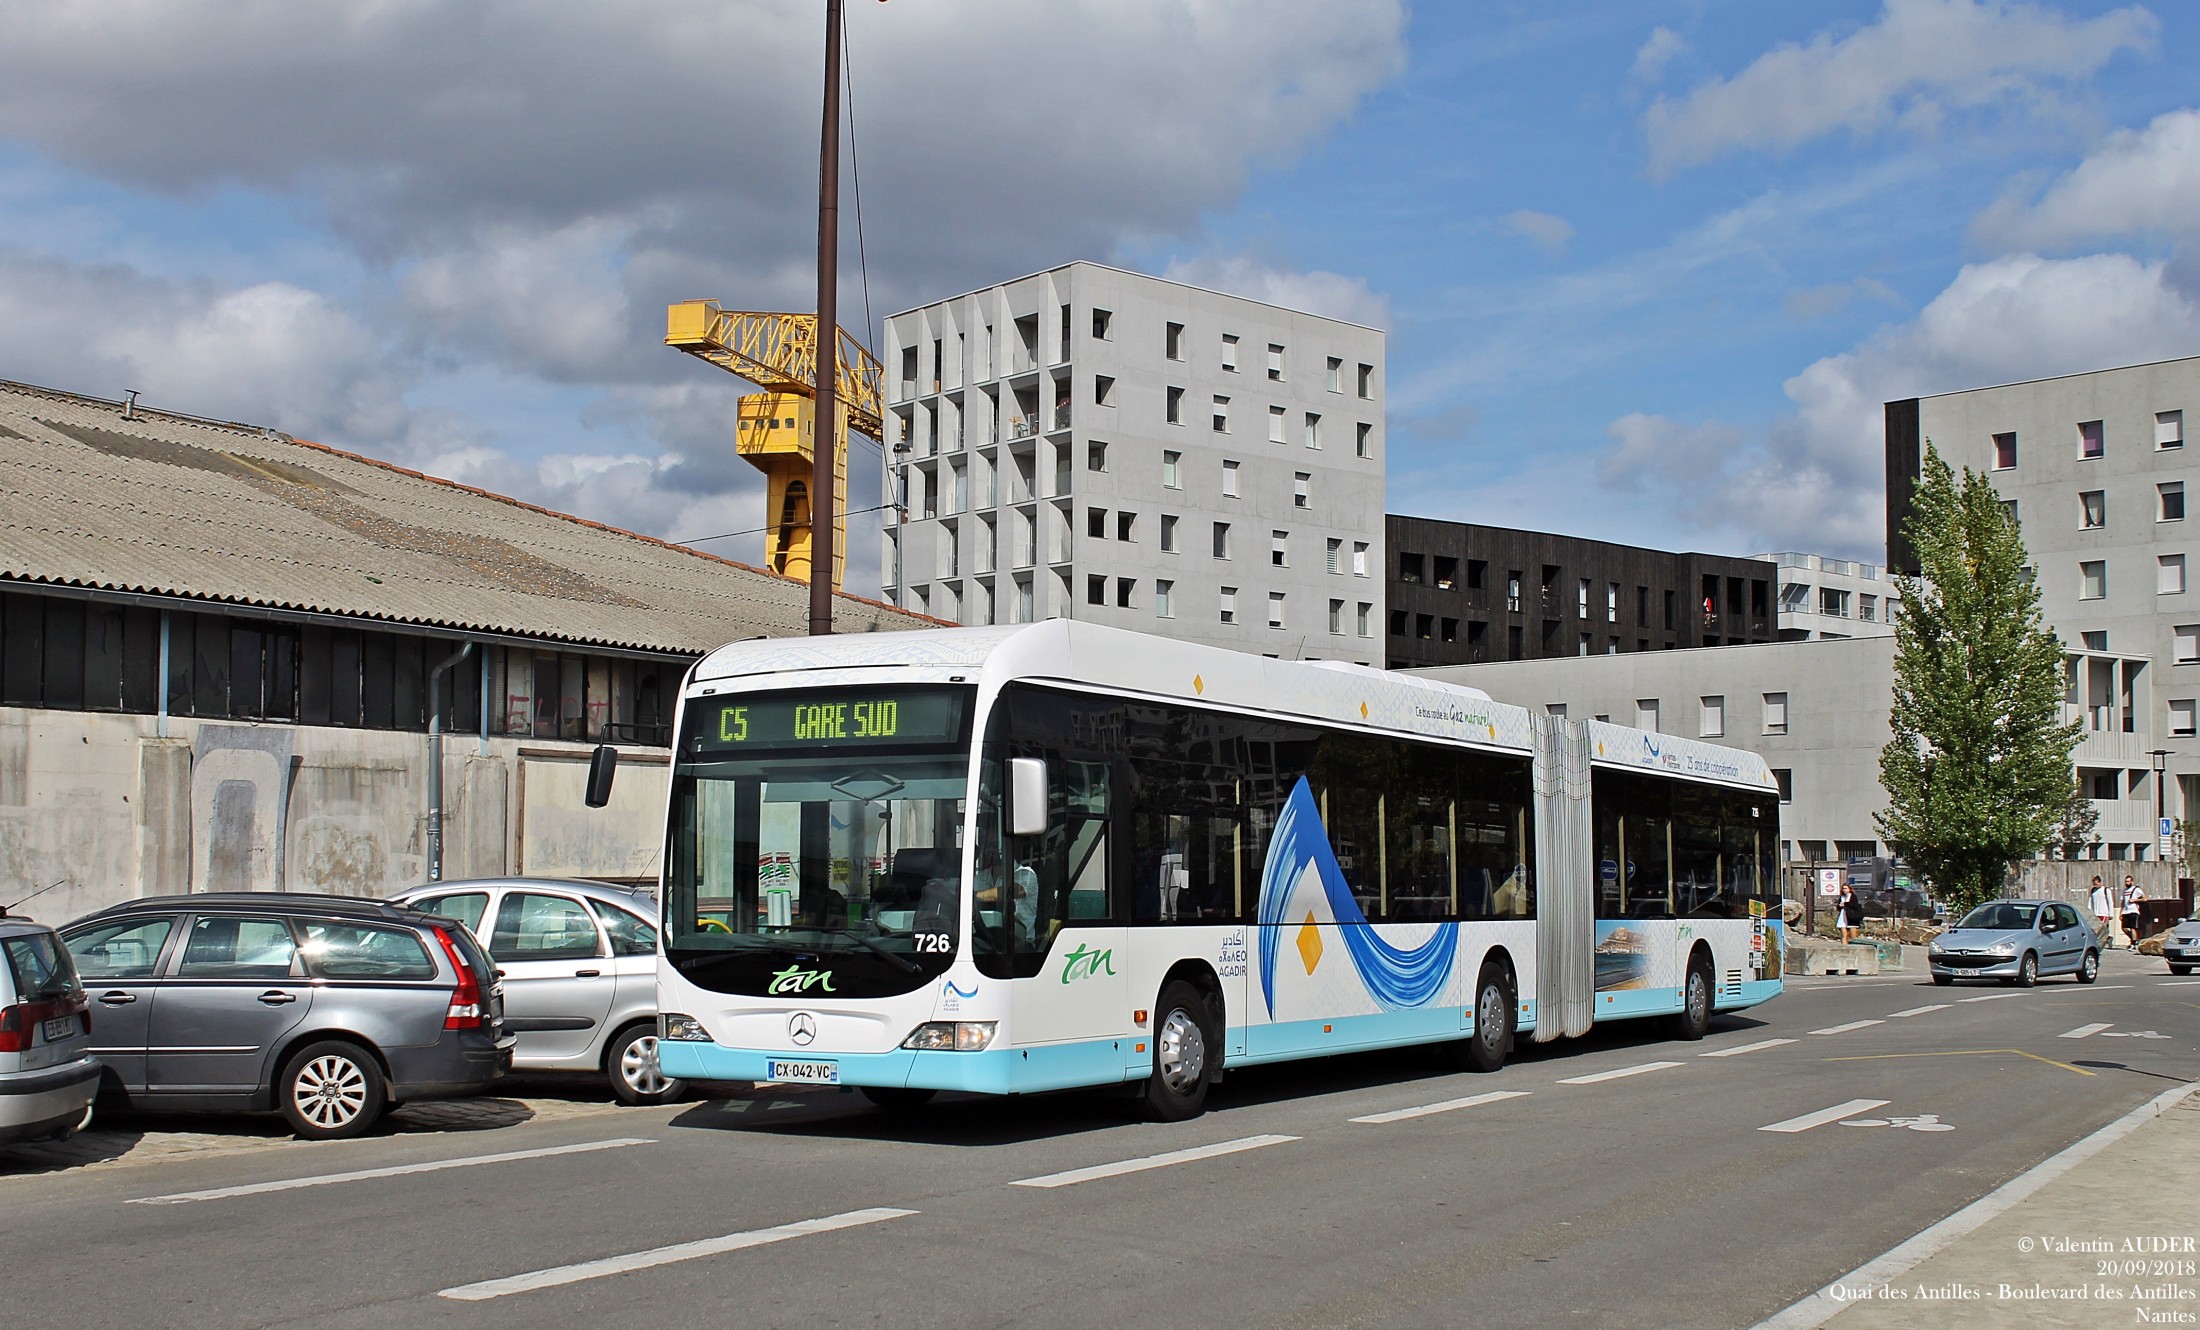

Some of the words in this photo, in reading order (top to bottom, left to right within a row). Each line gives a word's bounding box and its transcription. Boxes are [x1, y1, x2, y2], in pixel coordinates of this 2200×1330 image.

[720, 706, 748, 742] C5
[794, 702, 847, 740] GARE
[853, 699, 897, 737] SUD
[1449, 704, 1463, 725] Gaz
[1464, 708, 1489, 727] naturel
[1694, 760, 1703, 771] ans
[1703, 758, 1710, 772] de
[1710, 762, 1739, 778] coopération
[914, 934, 950, 952] 726
[1061, 943, 1117, 985] tan
[1218, 965, 1247, 977] AGADIR
[768, 964, 837, 995] tan
